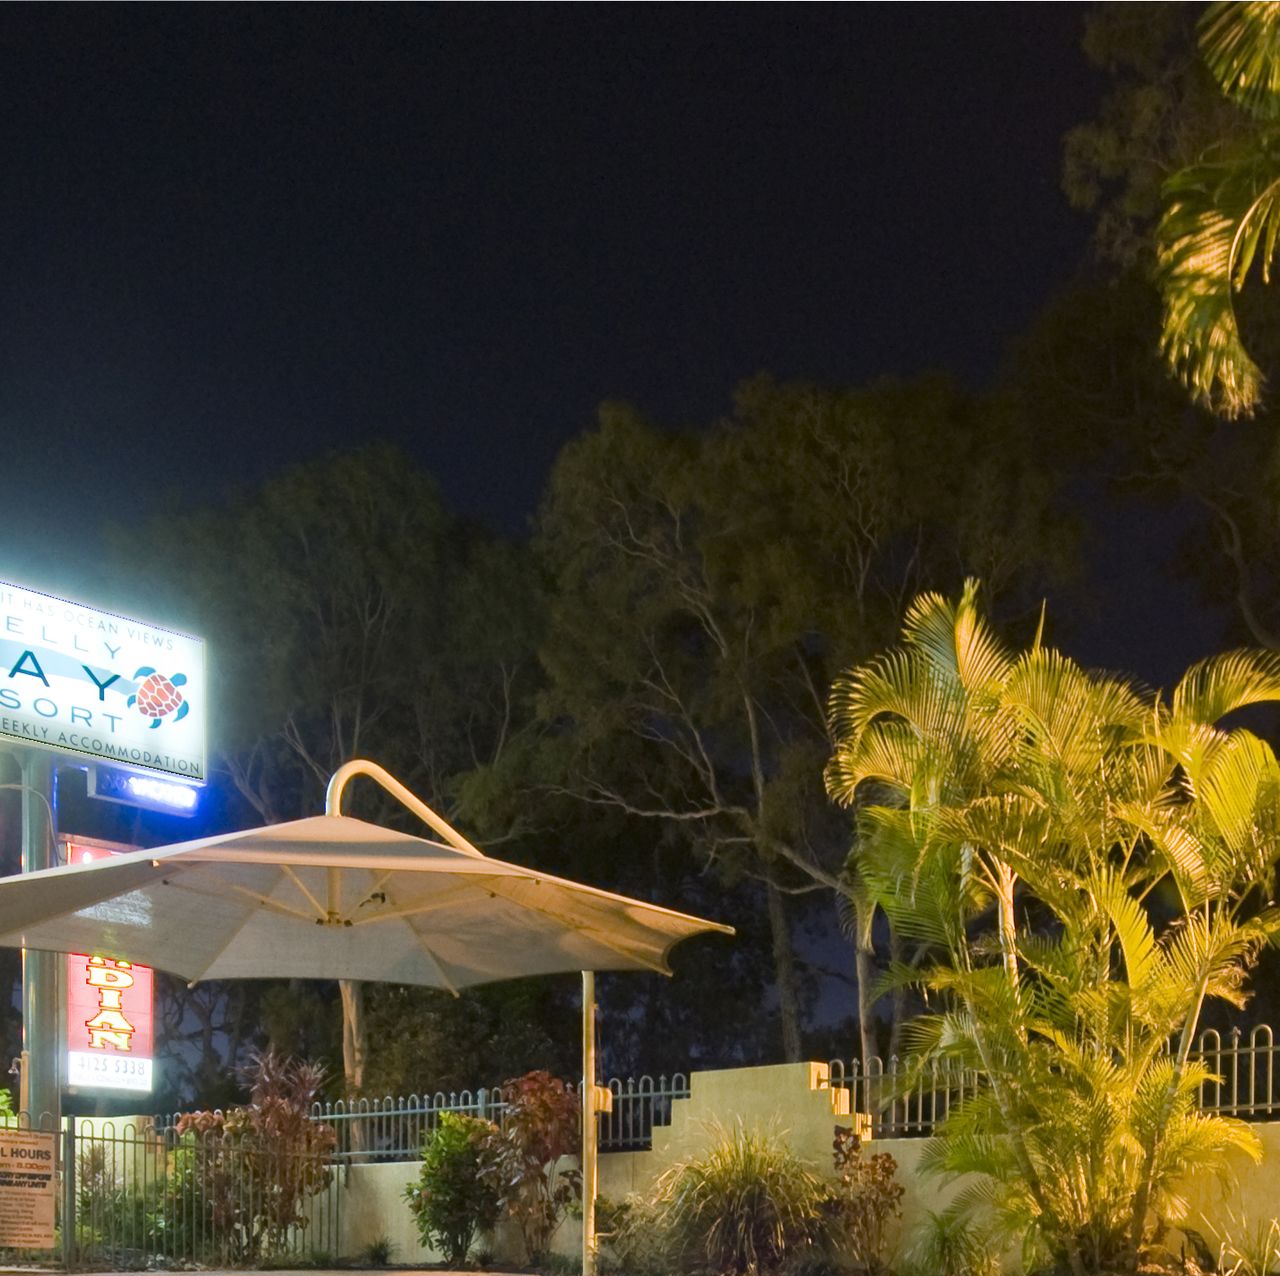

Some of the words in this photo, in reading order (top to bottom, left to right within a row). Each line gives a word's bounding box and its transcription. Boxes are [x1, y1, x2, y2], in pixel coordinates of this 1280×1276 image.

[23, 600, 55, 616] HAS
[64, 611, 118, 634] OCEAN
[127, 628, 173, 650] VIEWS
[58, 732, 200, 774] ACCOMMODATION
[85, 956, 135, 1051] DIAN
[114, 1059, 145, 1076] 5338
[11, 1147, 52, 1161] HOURS
